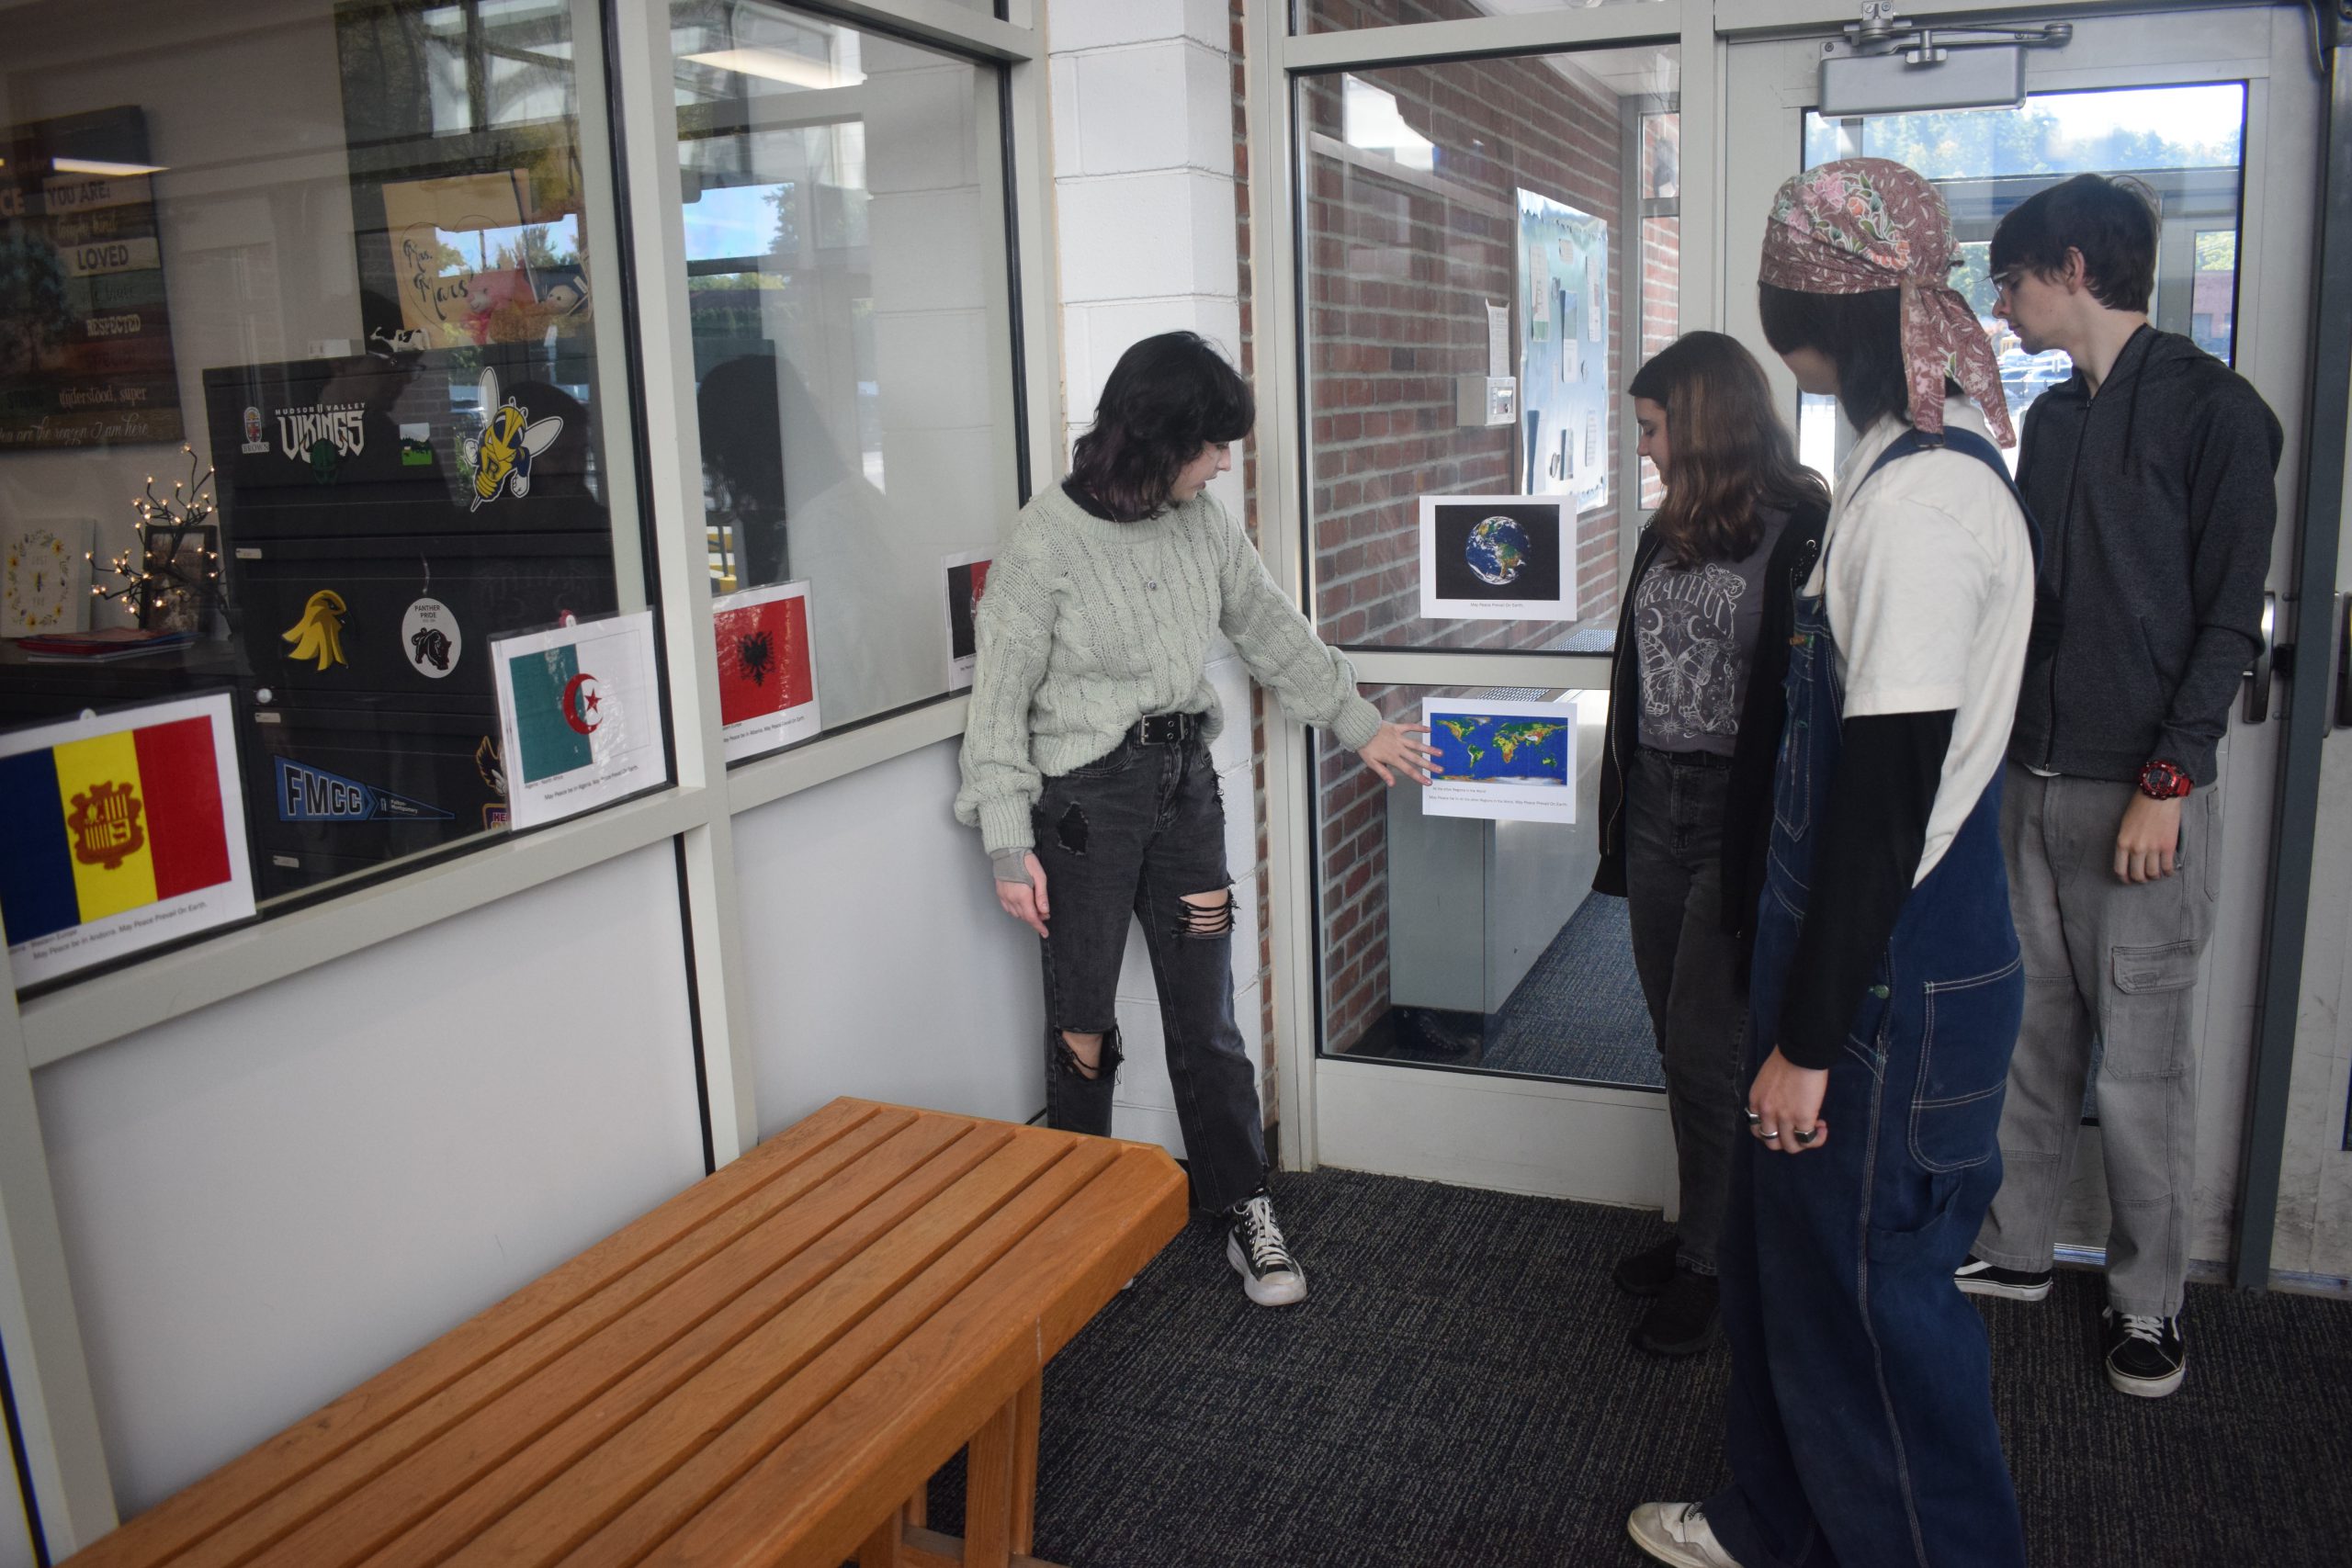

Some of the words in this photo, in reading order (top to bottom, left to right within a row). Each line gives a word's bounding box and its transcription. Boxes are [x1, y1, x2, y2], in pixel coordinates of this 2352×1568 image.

[47, 186, 75, 207] YOU
[77, 244, 129, 270] LOVED
[85, 313, 142, 339] RESPECTED
[119, 388, 147, 407] super
[275, 406, 314, 415] HUDSON
[326, 402, 366, 412] VALLEY
[29, 415, 51, 441] the
[121, 412, 149, 435] here
[277, 410, 366, 464] VIKINGS
[243, 444, 270, 453] BROWN
[1635, 573, 1727, 636] GRATEFUL
[284, 763, 363, 817] FMCC
[33, 951, 48, 960] May
[50, 944, 70, 954] Peace
[119, 924, 133, 933] May
[134, 918, 153, 928] Peace
[154, 909, 176, 921] Prevail
[177, 907, 187, 915] On
